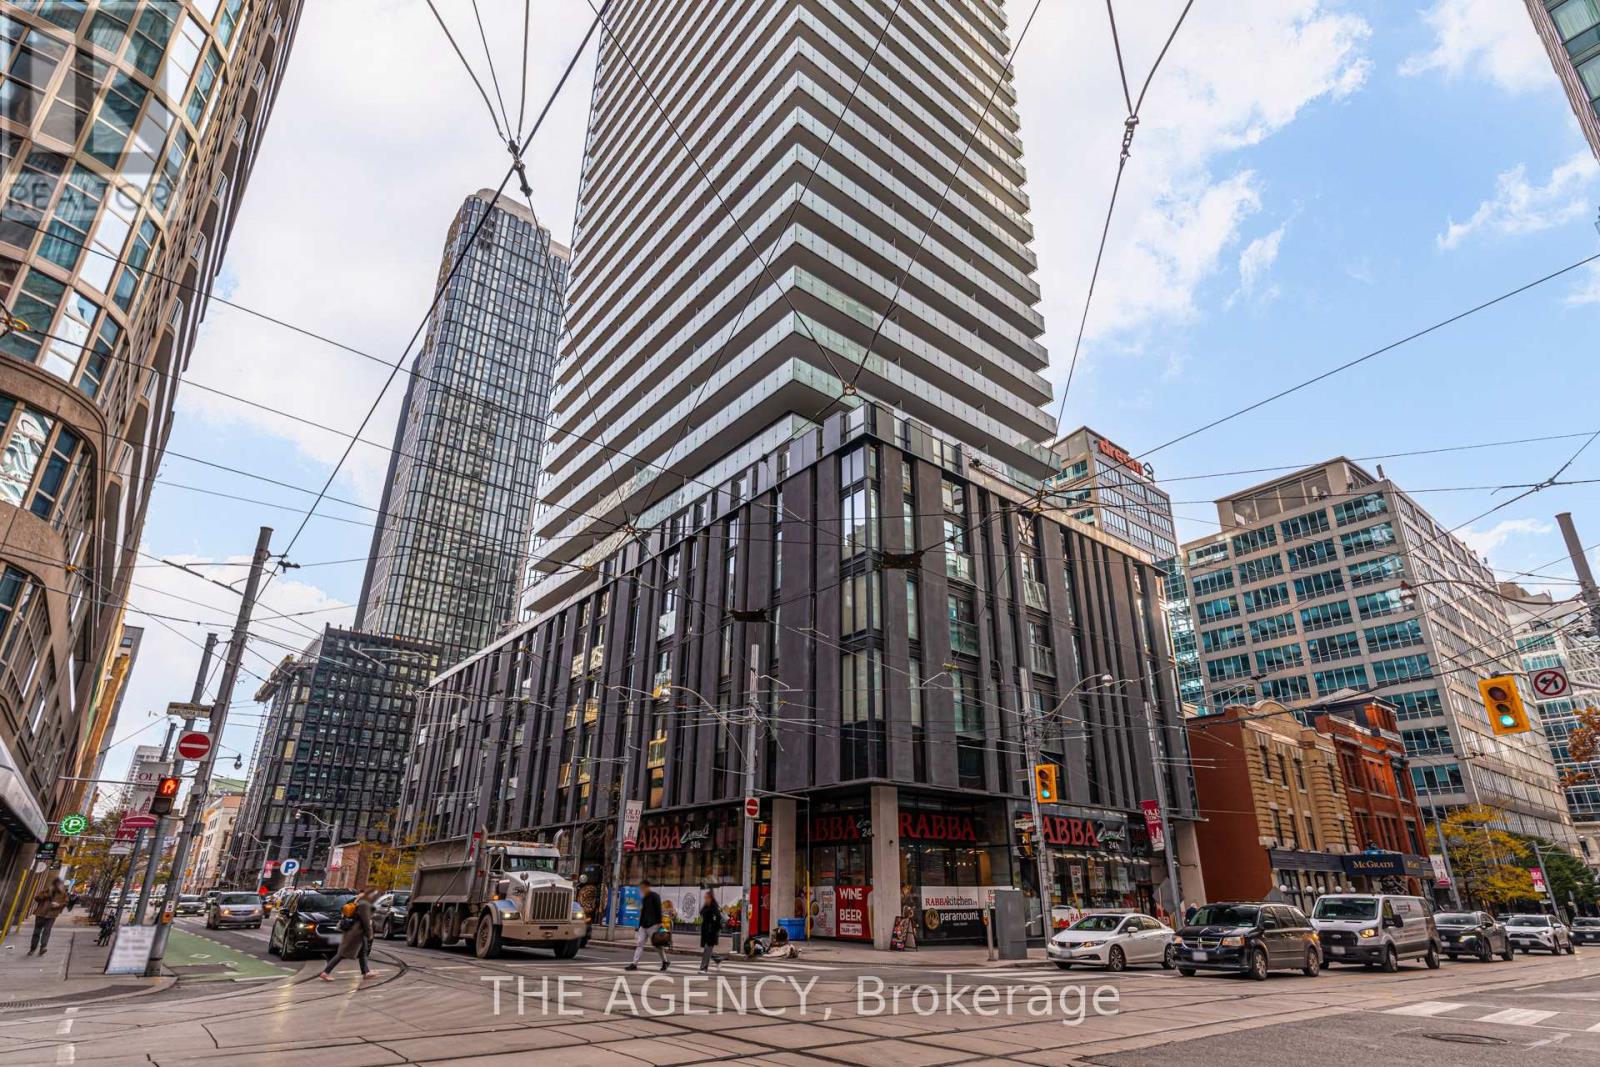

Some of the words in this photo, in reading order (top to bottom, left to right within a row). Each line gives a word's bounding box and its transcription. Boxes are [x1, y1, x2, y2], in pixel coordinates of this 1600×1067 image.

[69, 819, 81, 829] P
[900, 812, 976, 842] RABBA
[638, 823, 682, 849] ABBA
[1042, 815, 1100, 846] ABBA
[284, 861, 296, 873] P
[840, 888, 862, 900] WINE
[840, 909, 862, 921] BEER
[940, 911, 979, 924] paramount
